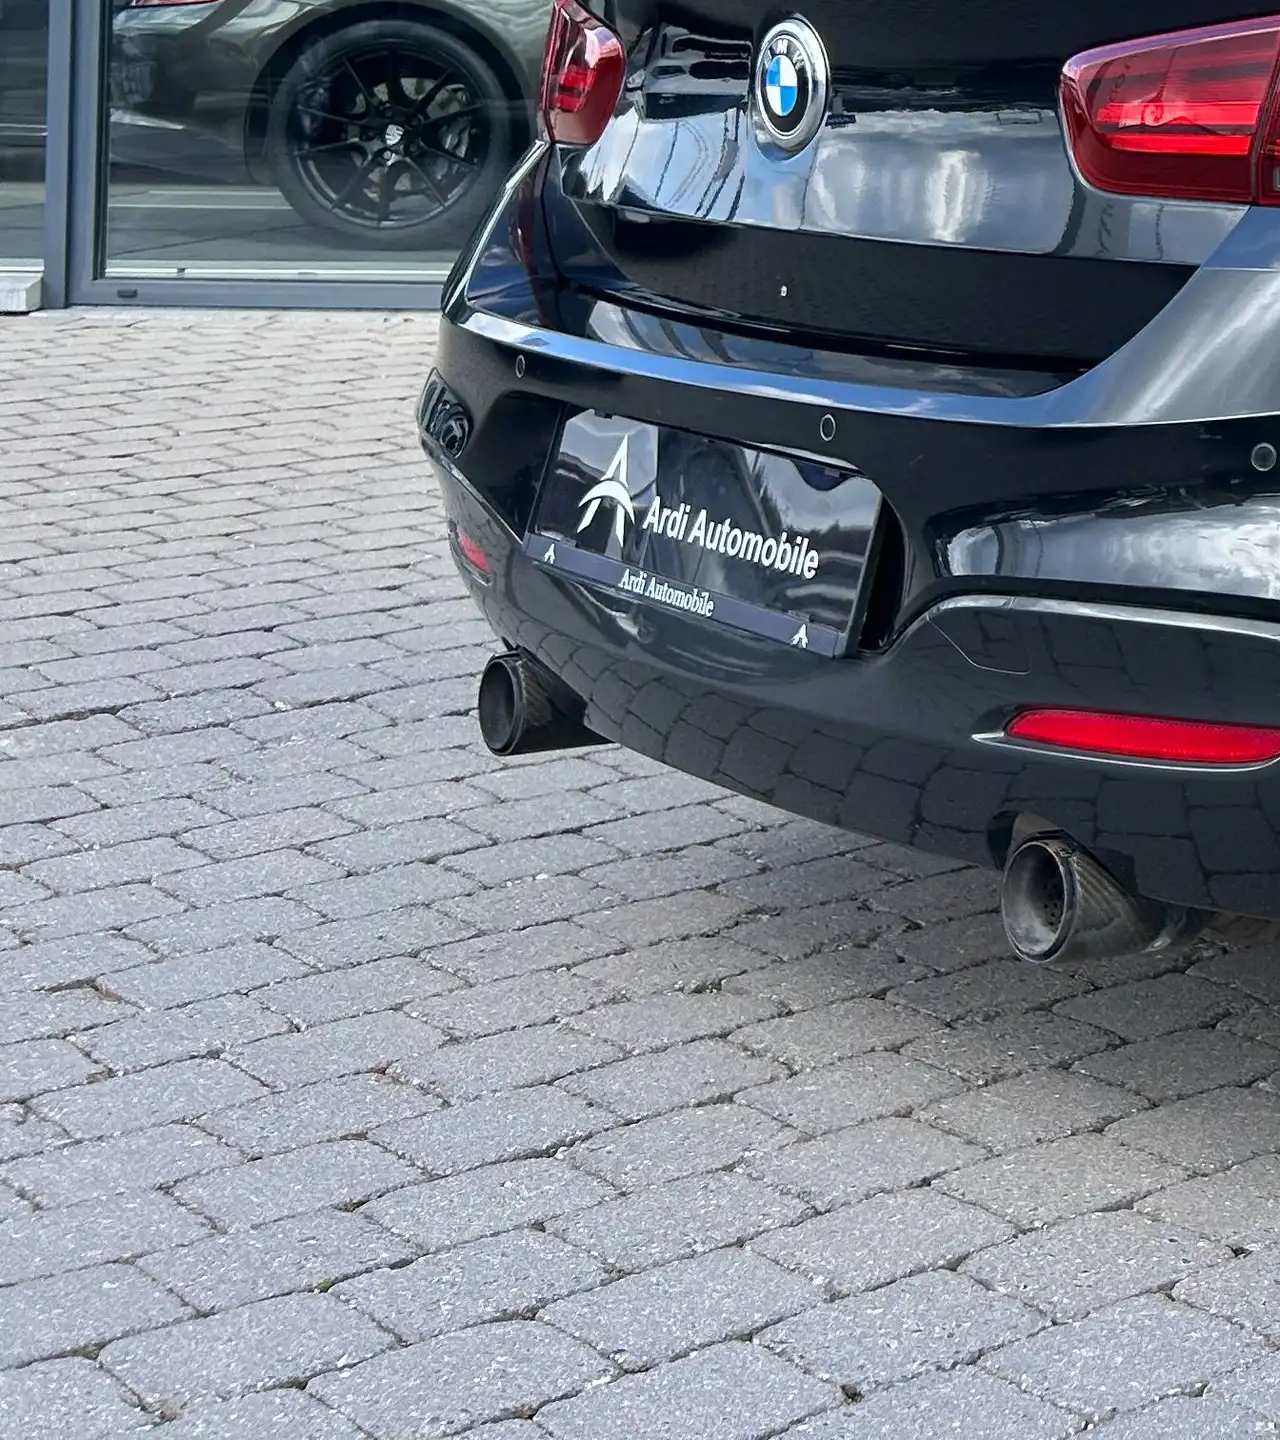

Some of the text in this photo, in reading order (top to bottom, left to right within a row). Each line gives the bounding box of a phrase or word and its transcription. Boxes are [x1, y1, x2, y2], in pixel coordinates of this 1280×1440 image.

[642, 495, 820, 580] Ardi Automobile
[618, 568, 716, 617] Ardi Automobile
